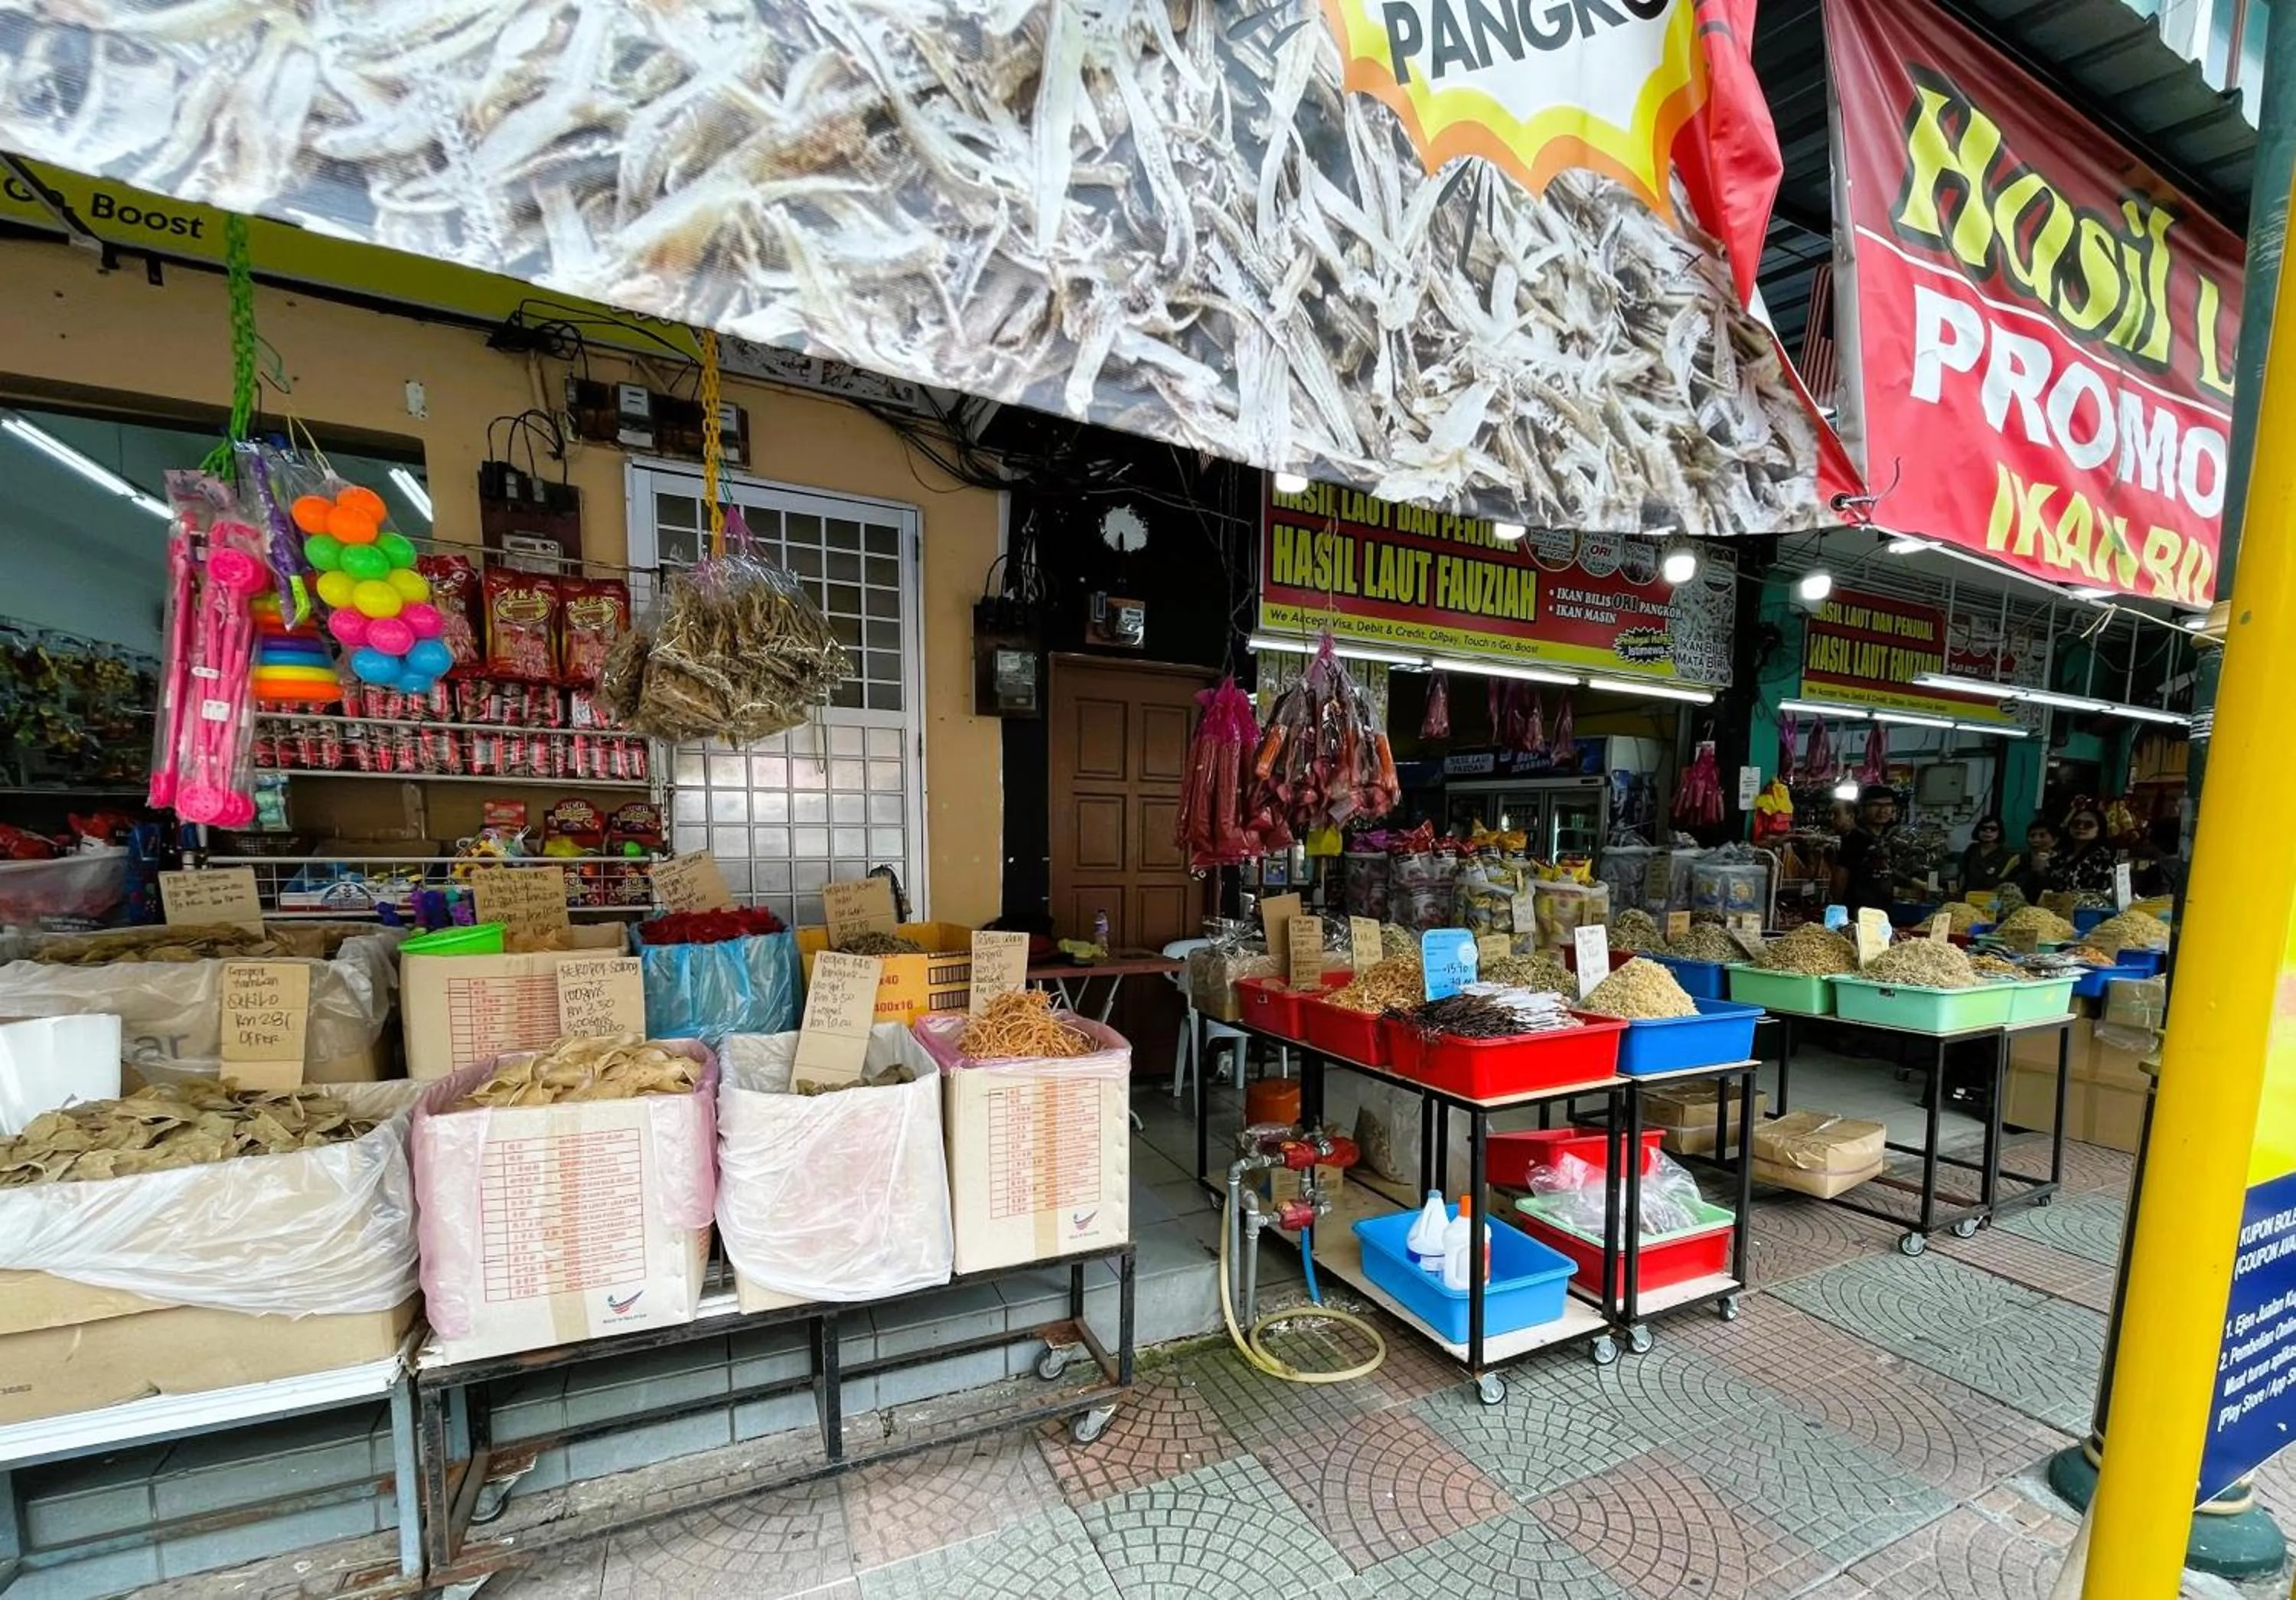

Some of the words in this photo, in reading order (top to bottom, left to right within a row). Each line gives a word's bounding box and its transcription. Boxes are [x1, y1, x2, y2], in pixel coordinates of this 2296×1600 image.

[1382, 0, 1668, 86] PANGK
[91, 192, 205, 239] Boost
[1896, 83, 2175, 366] Hasil
[1909, 283, 2229, 521] PROMO
[1341, 488, 1391, 529] LAUT
[1397, 499, 1437, 537] DAN
[1985, 461, 2140, 591] IKAN
[1590, 544, 1612, 557] ORI
[1271, 524, 1359, 596] HASIL
[1364, 540, 1433, 606] LAUT
[1436, 554, 1538, 622] FAUZIAH
[1555, 604, 1583, 621] IKAN
[1584, 607, 1617, 625] MASIN
[1556, 587, 1583, 603] IKAN
[1584, 589, 1612, 607] BILIS
[1612, 592, 1639, 612] ORI
[1639, 602, 1682, 619] PANGKOR
[1270, 609, 1288, 622] We
[1357, 621, 1384, 635] Debit
[1386, 624, 1393, 635] &
[1463, 635, 1489, 648] Touch
[1844, 605, 1872, 629] LAUT
[1894, 615, 1935, 642] PENJUAL
[1677, 652, 1704, 667] MATA
[1679, 637, 1704, 652] IKAN
[1808, 632, 1851, 674] HASIL
[1853, 640, 1890, 680] LAUT
[2239, 1216, 2275, 1247] KUPON
[2234, 1312, 2256, 1338] Ejen
[2242, 1388, 2266, 1413] Store
